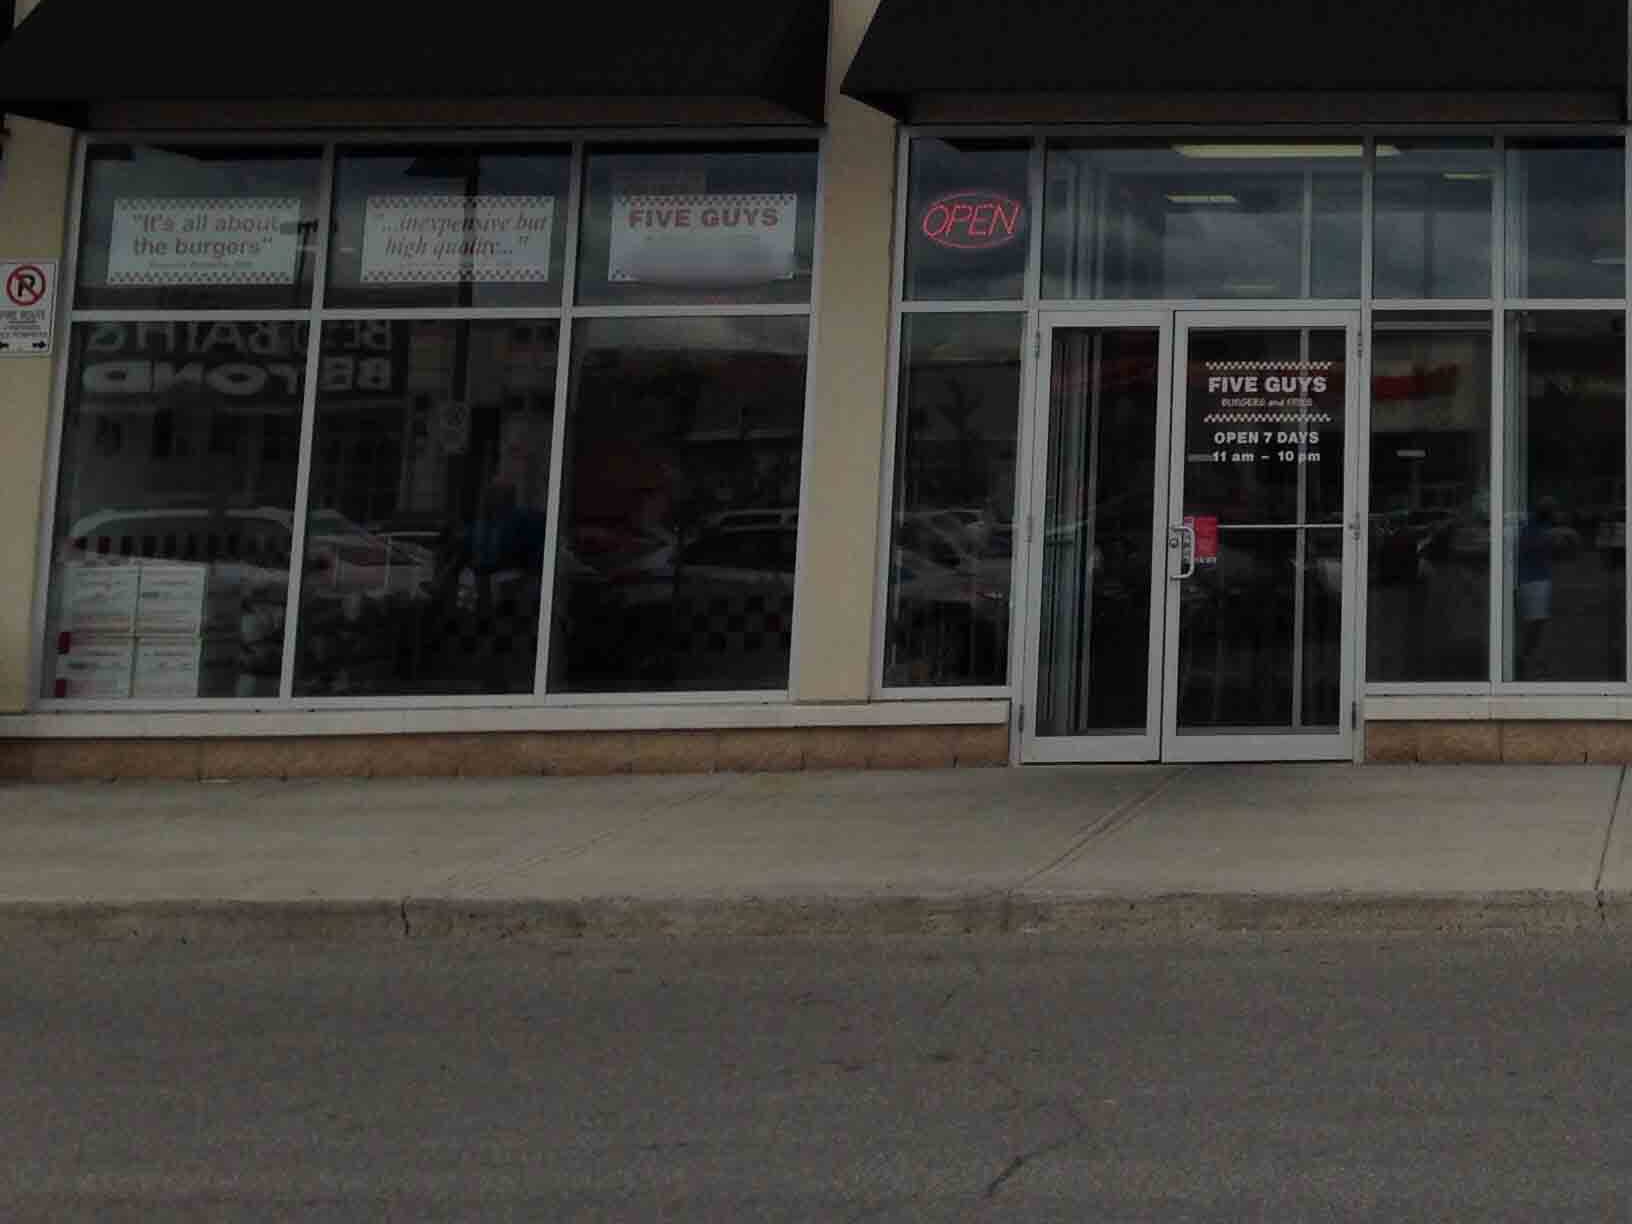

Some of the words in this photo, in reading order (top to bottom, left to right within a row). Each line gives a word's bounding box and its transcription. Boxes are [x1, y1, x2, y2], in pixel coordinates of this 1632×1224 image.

[182, 213, 207, 233] all
[215, 213, 280, 233] about
[514, 210, 547, 233] but
[629, 208, 691, 227] FIVE
[701, 208, 779, 227] GUYS
[922, 200, 1020, 237] OPEN
[133, 236, 169, 256] the
[385, 235, 427, 258] high
[1208, 376, 1258, 392] FIVE
[1264, 376, 1328, 392] GUYS
[1214, 431, 1259, 445] OPEN
[1263, 431, 1273, 444] 7
[1277, 431, 1320, 445] DAYS
[1212, 450, 1227, 463] 11
[1231, 452, 1255, 463] am
[1277, 450, 1294, 463] 10
[1297, 452, 1321, 465] pm
